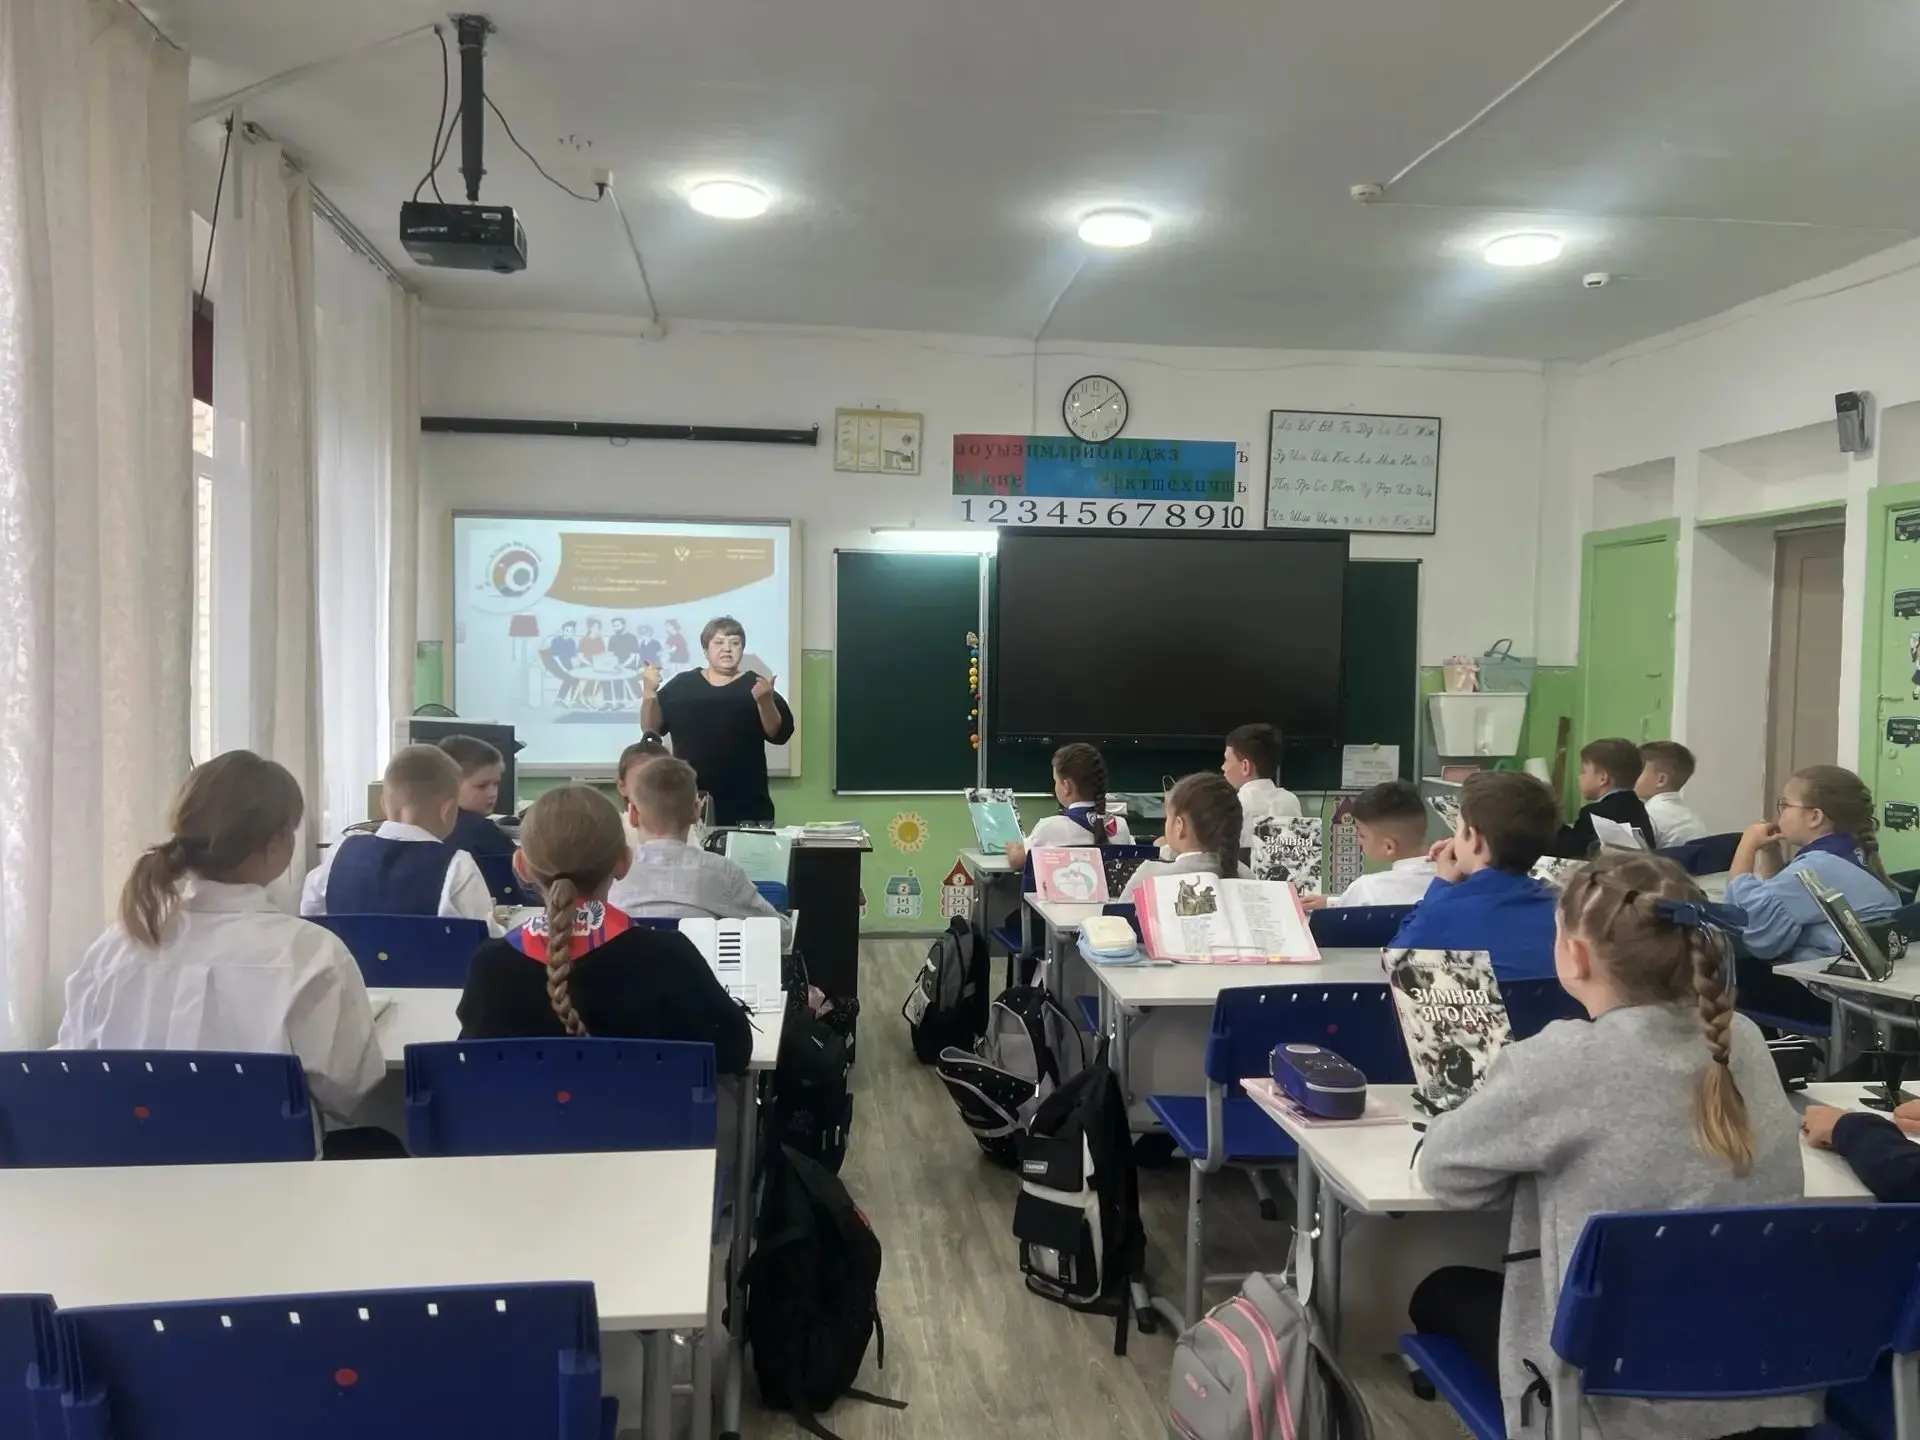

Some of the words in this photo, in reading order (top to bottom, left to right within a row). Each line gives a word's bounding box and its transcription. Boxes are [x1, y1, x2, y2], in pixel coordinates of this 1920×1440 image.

[961, 500, 975, 522] 1
[988, 500, 1008, 523] 2
[1017, 500, 1038, 524] 3
[1046, 501, 1069, 525] 4
[1077, 502, 1097, 525] 5
[1107, 502, 1128, 526] 6
[1136, 503, 1157, 526] 7
[1165, 504, 1186, 527] 8
[1194, 504, 1215, 528] 9
[1221, 505, 1244, 528] 10
[1263, 836, 1313, 847] ЗИМНЯЯ
[1410, 987, 1490, 1005] ЗИМНЯЯ
[1422, 1007, 1489, 1026] ЯГОДА
